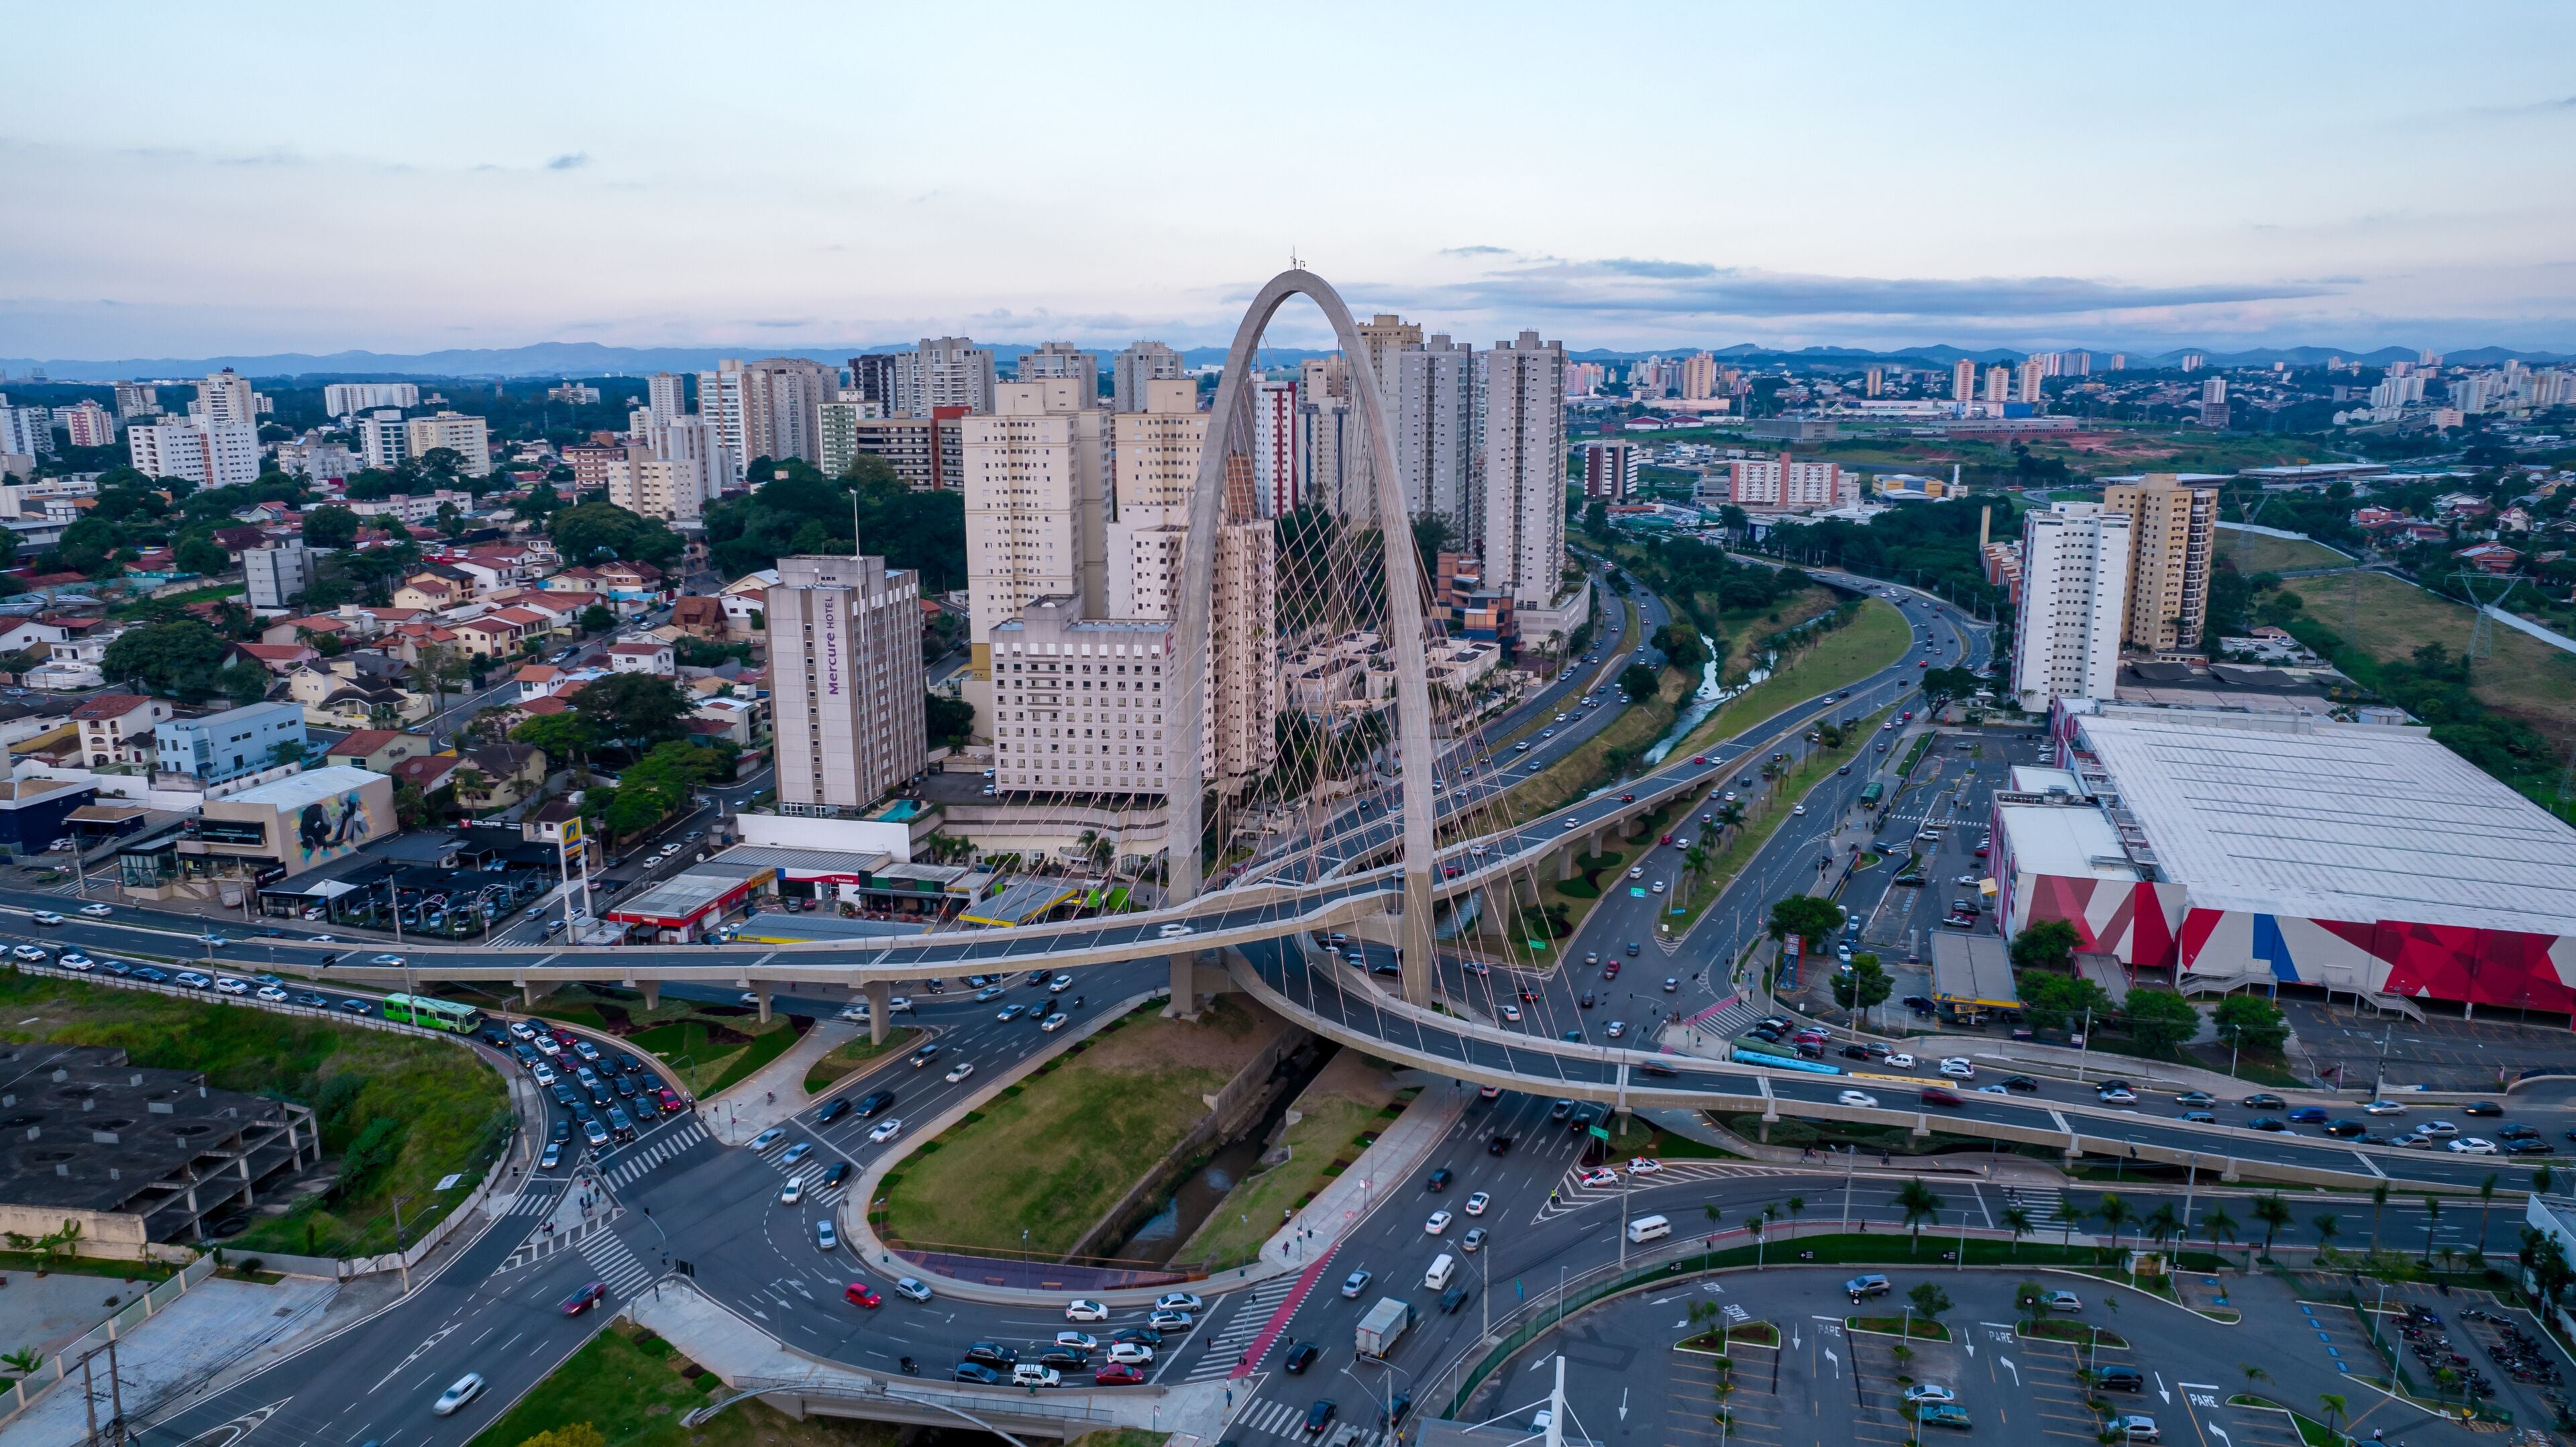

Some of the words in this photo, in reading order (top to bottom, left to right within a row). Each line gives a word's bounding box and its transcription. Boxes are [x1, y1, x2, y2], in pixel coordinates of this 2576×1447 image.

[824, 596, 835, 629] HOTEL
[826, 632, 839, 695] Mercure
[1817, 1324, 1841, 1338] PARE
[1988, 1330, 2013, 1344] PARE
[2189, 1393, 2219, 1409] PARE
